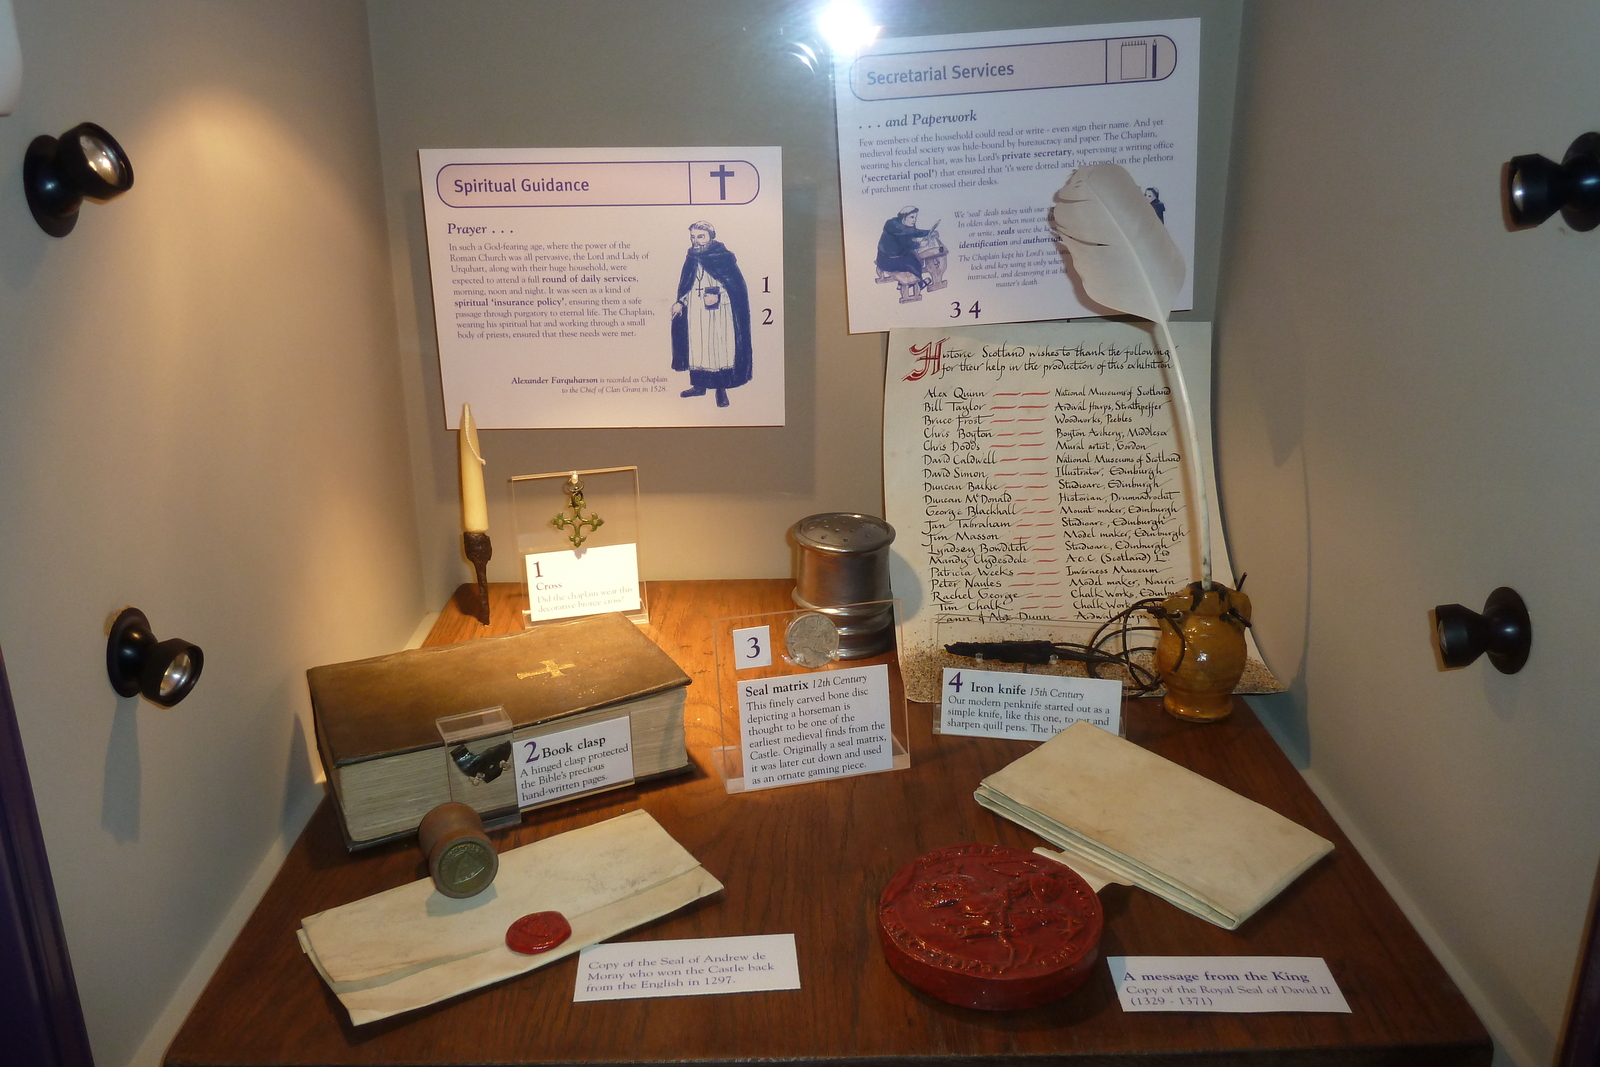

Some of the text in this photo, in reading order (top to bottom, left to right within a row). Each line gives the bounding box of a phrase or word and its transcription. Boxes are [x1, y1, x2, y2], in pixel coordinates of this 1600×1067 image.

[867, 62, 1015, 85] Secretarial Services
[885, 110, 977, 127] and Paperwork
[454, 178, 590, 196] Spiritual Guidance
[861, 176, 999, 196] of parchment that crossed their desks.
[447, 222, 487, 237] Prayer
[959, 239, 1008, 250] identification
[1010, 238, 1022, 246] and
[451, 275, 484, 287] expected
[496, 275, 520, 284] attend
[527, 275, 540, 284] full
[541, 275, 567, 283] round
[568, 274, 578, 283] of
[580, 274, 601, 286] daily
[603, 274, 639, 284] services,
[762, 276, 771, 294] 1
[454, 298, 489, 309] spiritual
[569, 296, 600, 308] ensuring
[601, 296, 620, 305] them
[628, 296, 642, 305] safe
[950, 300, 982, 319] 3 4
[761, 308, 774, 326] 2
[982, 341, 1026, 359] Scotland
[1029, 345, 1059, 357] wishes
[1062, 346, 1071, 357] to
[1075, 341, 1105, 357] thank
[1108, 342, 1121, 355] the
[1124, 343, 1171, 362] following
[510, 376, 549, 384] Alexander
[550, 376, 598, 387] Farquharson
[599, 376, 605, 384] is
[606, 376, 631, 384] recorded
[640, 375, 668, 386] Chaplain
[924, 386, 988, 400] Alex Quinn
[923, 399, 986, 416] Bill Taylor
[1055, 413, 1133, 425] Woodworks, Peebles
[922, 453, 951, 465] David
[533, 561, 543, 578] 1
[928, 566, 971, 578] Patricia
[1066, 565, 1162, 576] Inverness Museum
[535, 582, 562, 590] Cross
[929, 579, 960, 592] Peter
[1069, 575, 1103, 587] Model
[1107, 576, 1140, 588] maker,
[746, 637, 761, 658] 3
[745, 675, 867, 697] Seal matrix 12th Century
[948, 672, 963, 693] 4
[970, 682, 1084, 701] Iron knife 15th Century
[746, 687, 869, 711] This finely carved bone disc
[947, 694, 967, 705] Our
[968, 696, 1001, 707] modern
[1004, 699, 1042, 711] penknife
[1044, 702, 1074, 712] started
[1075, 705, 1091, 713] out
[946, 717, 980, 731] sharpen
[983, 720, 1002, 732] quill
[1004, 724, 1027, 733] pens.
[1031, 722, 1049, 733] The
[749, 721, 886, 748] earliest medieval finds from the
[524, 741, 540, 763] 2
[542, 737, 606, 758] Book clasp
[749, 748, 781, 760] Castle.
[783, 741, 827, 757] Originally
[837, 736, 853, 748] seal
[857, 733, 887, 745] matrix,
[520, 743, 629, 778] A hinged clasp protected
[521, 780, 536, 790] the
[569, 763, 605, 779] precious
[777, 770, 805, 781] ornate
[808, 764, 839, 780] gaming
[842, 761, 867, 775] piece.
[522, 775, 608, 801] hand-written pages.
[588, 951, 766, 972] Copy of the Seal of Andrew de
[587, 971, 625, 982] Moray
[628, 968, 654, 978] who
[685, 965, 705, 975] the
[707, 963, 744, 974] Castle
[748, 961, 774, 972] back
[1123, 971, 1309, 984] A message from the King
[585, 975, 735, 992] from the English in 1297.
[1125, 985, 1331, 997] Copy of the Royal Seal of David II
[1130, 997, 1165, 1007] (1329
[1180, 997, 1213, 1008] 1371)
